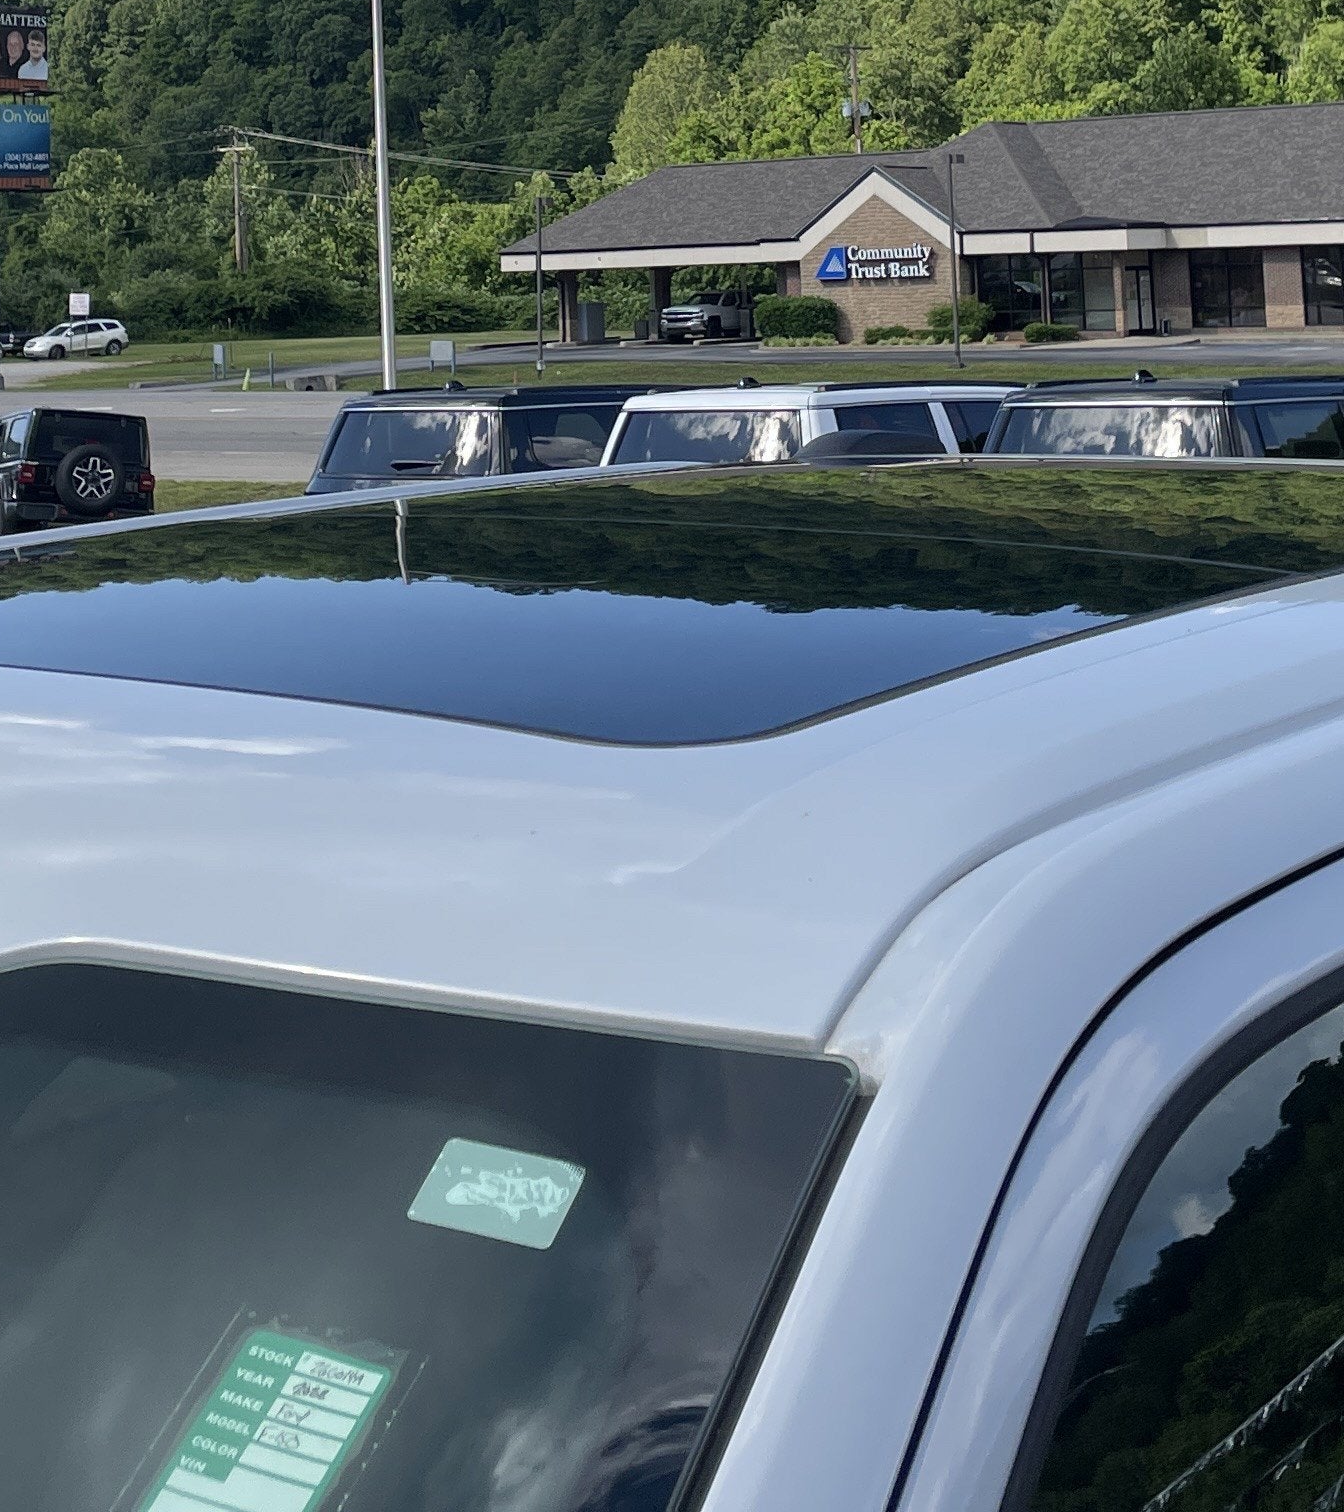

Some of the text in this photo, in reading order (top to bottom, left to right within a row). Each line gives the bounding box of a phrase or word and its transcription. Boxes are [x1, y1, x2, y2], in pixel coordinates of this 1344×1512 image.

[2, 108, 21, 123] On
[23, 109, 49, 124] You!
[847, 242, 932, 262] Community
[848, 260, 930, 279] Trust Bank
[248, 1345, 295, 1368] STOCK
[235, 1367, 276, 1389] YEAR
[219, 1389, 264, 1413] MAKE
[205, 1412, 251, 1436] MODEL
[191, 1434, 239, 1459] COLOR
[179, 1455, 207, 1474] VIN
